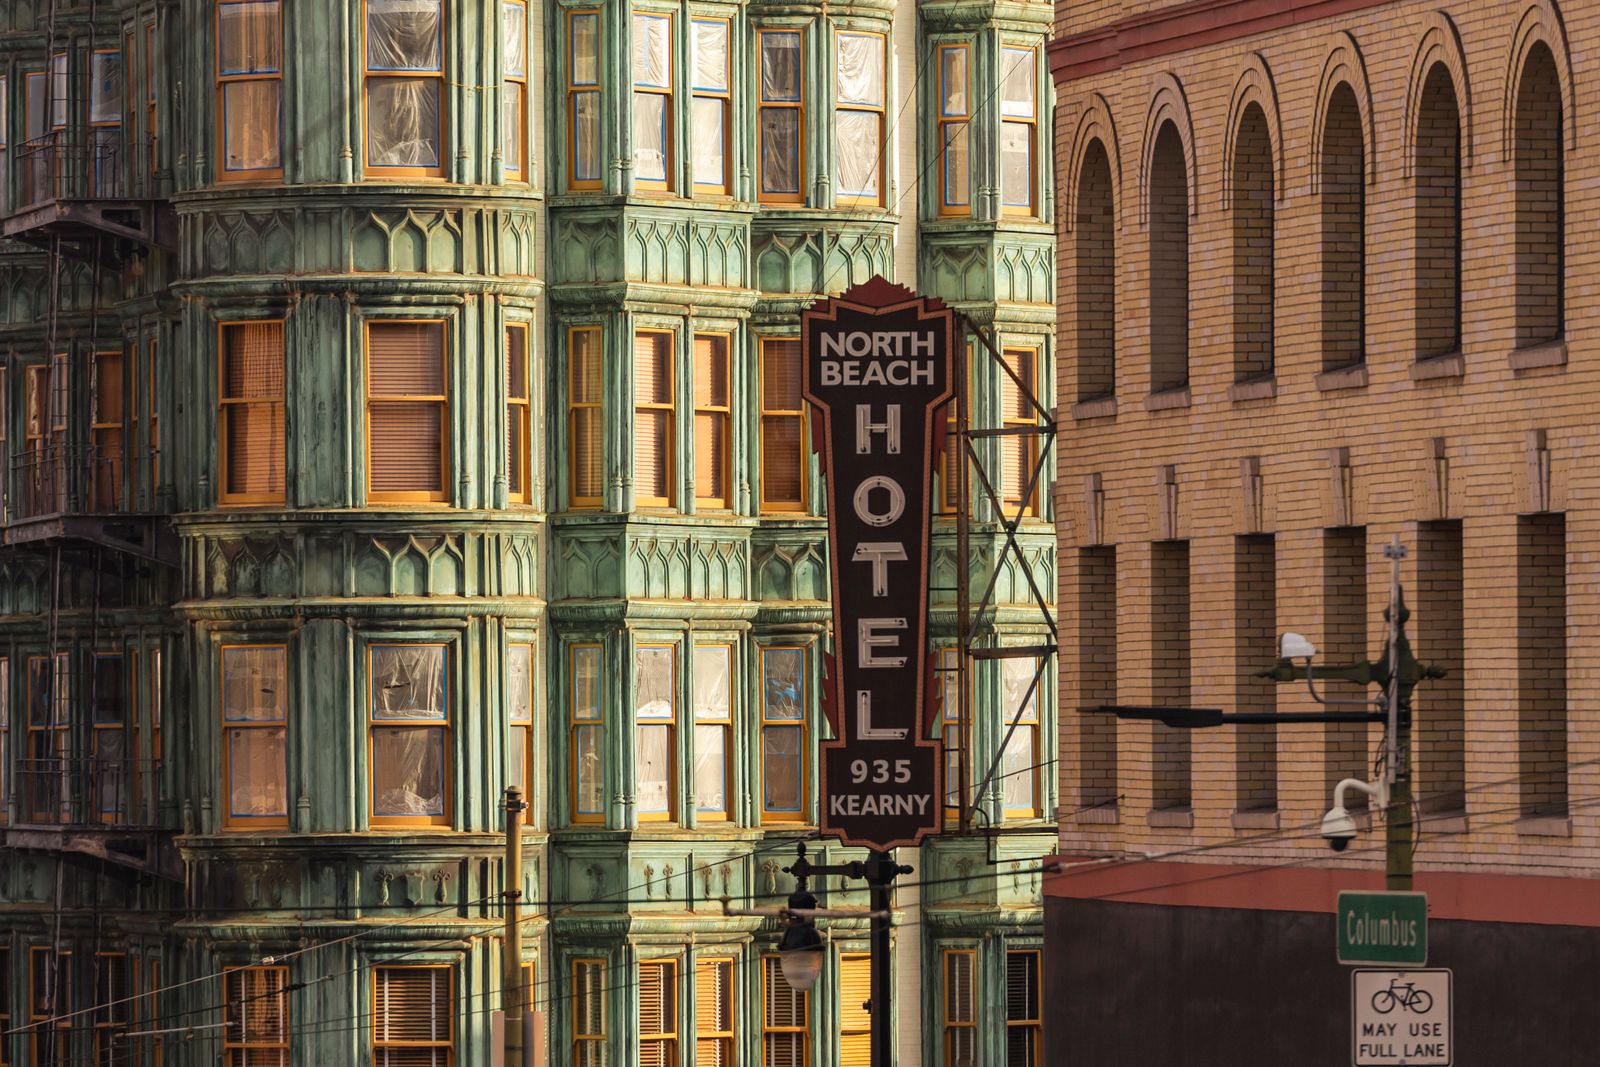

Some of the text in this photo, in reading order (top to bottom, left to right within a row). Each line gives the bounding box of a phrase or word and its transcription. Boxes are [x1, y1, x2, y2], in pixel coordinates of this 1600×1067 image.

[820, 331, 934, 357] NORTH
[821, 360, 934, 386] BEACH
[851, 404, 909, 740] HOTEL
[850, 759, 911, 784] 935
[830, 794, 930, 816] KEARNY
[1346, 909, 1417, 947] Columbus
[1362, 1023, 1442, 1037] MAY USE
[1359, 1043, 1446, 1057] FULL LANE
